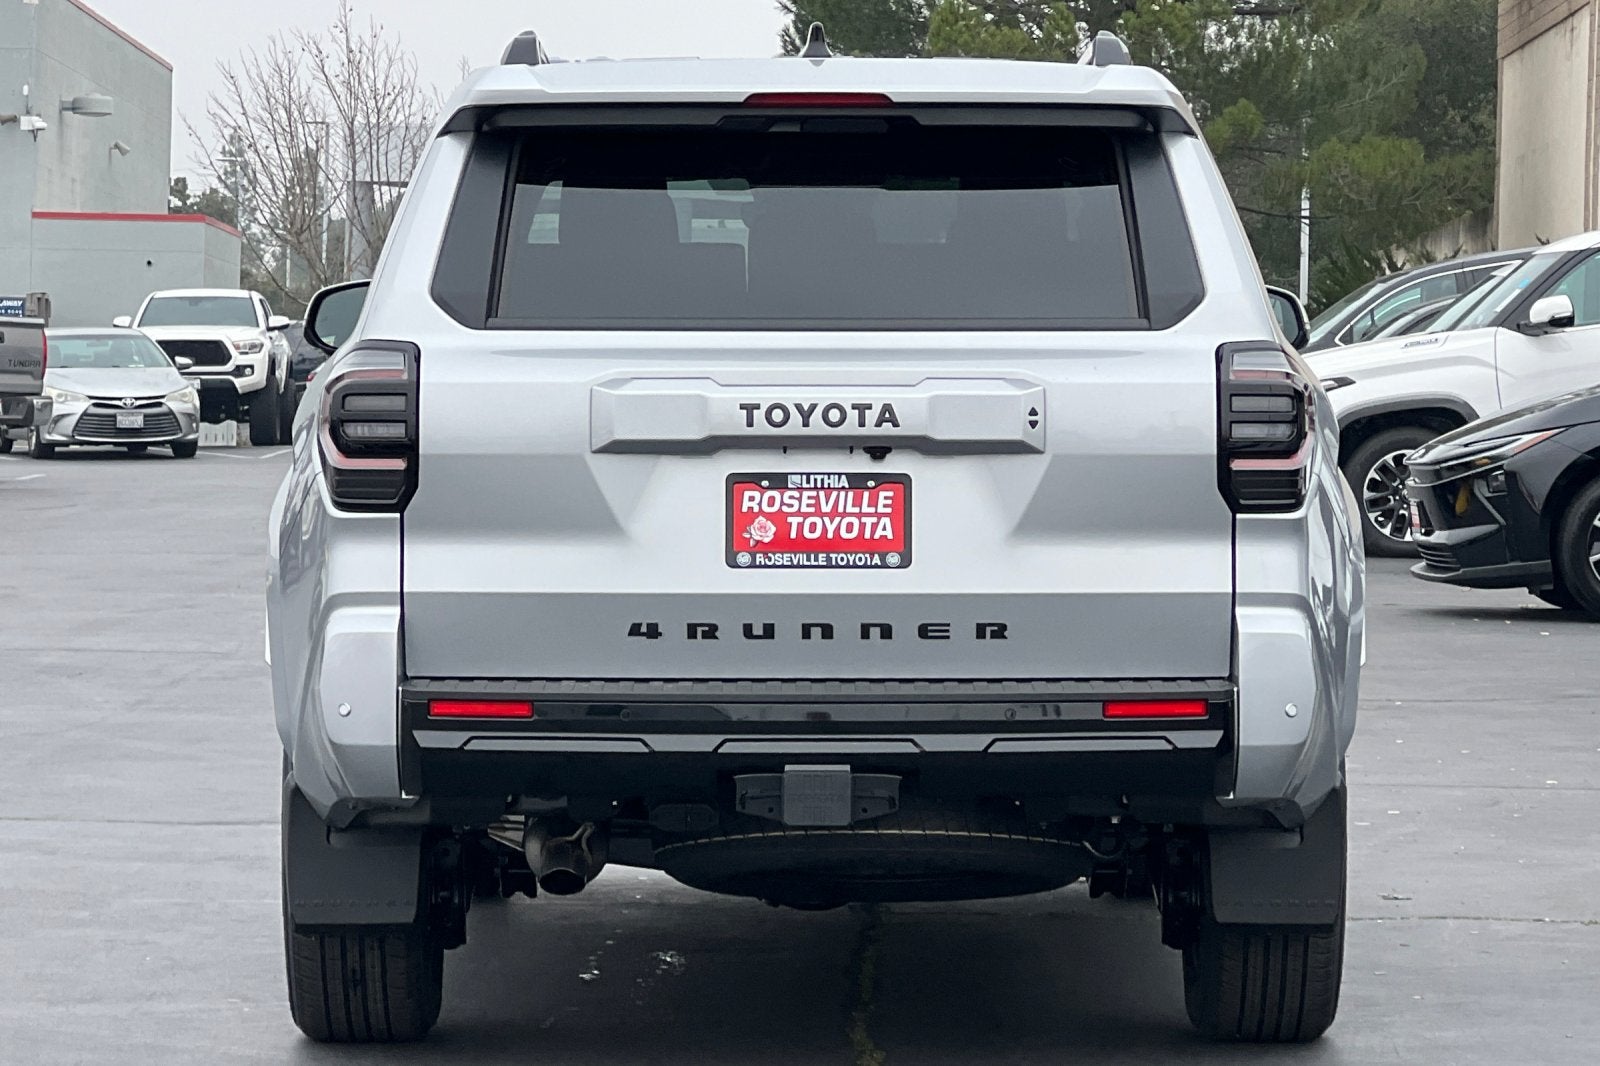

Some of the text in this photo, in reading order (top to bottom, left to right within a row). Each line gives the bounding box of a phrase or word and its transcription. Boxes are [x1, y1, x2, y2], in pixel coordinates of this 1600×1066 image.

[8, 359, 41, 368] TUNDRA
[739, 402, 900, 428] TOYOTA
[802, 474, 849, 488] LITHIA
[741, 490, 894, 513] ROSEVILLE
[786, 516, 894, 539] TOYOTA
[756, 553, 881, 566] ROSEVILLE TOYOTA
